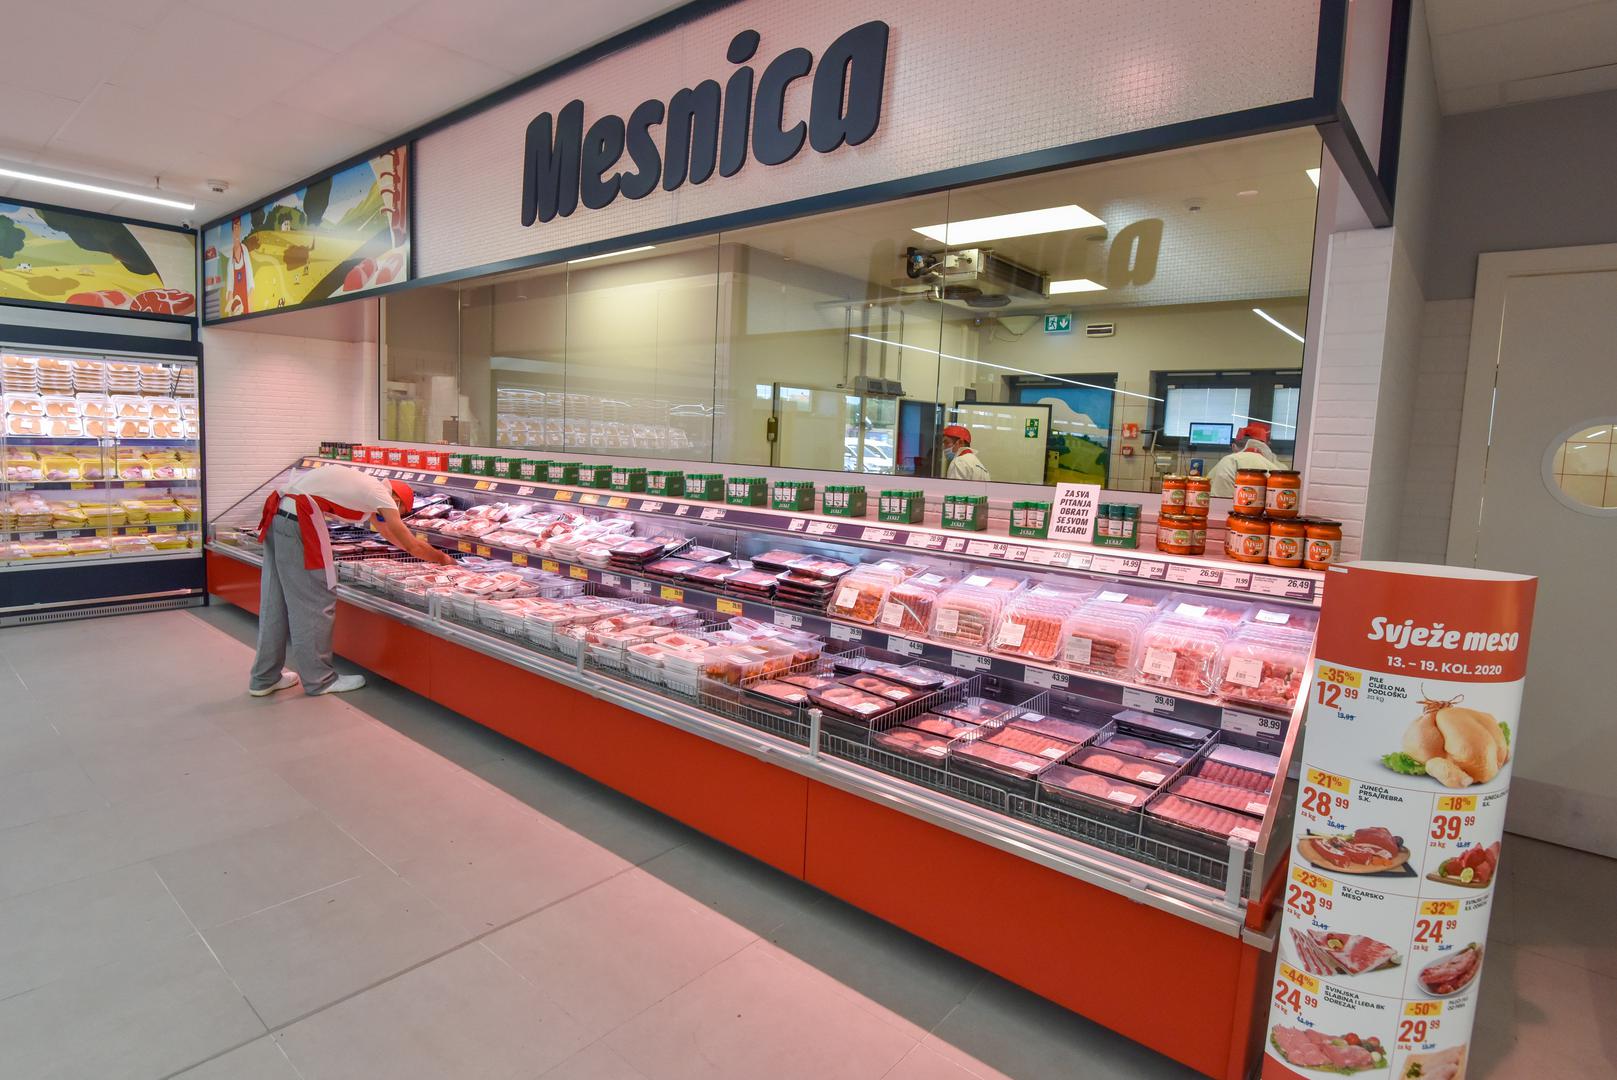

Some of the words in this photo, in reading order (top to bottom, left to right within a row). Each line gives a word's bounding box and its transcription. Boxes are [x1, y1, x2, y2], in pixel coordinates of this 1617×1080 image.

[521, 20, 889, 227] Mesnica
[1060, 499, 1092, 507] PITANJA
[1060, 508, 1089, 516] OBRATI
[1056, 516, 1066, 524] SE
[1066, 517, 1089, 526] SVOM
[1055, 525, 1087, 535] MESARU
[1200, 569, 1220, 578] 26.99
[1287, 579, 1310, 589] 26.49
[1367, 616, 1461, 650] Svježe
[1462, 631, 1520, 652] meso
[909, 641, 923, 651] 44.99
[976, 656, 991, 666] 41.99
[1387, 655, 1406, 668] 13.
[1420, 660, 1438, 672] 19.
[1441, 662, 1473, 675] KOL.
[1474, 665, 1503, 676] 2020
[1051, 673, 1070, 684] 43.99
[1323, 667, 1355, 684] -35%
[1369, 676, 1384, 684] PILE
[1367, 687, 1408, 699] PODLOŠKU
[1368, 682, 1394, 691] CIJELO
[1154, 695, 1175, 707] 39.49
[1258, 718, 1281, 731] 38.99
[1313, 771, 1343, 789] -21%
[1358, 789, 1404, 803] PRSA/REBRA
[1444, 796, 1471, 811] -18%
[1297, 871, 1327, 889] -23%
[1341, 892, 1362, 902] MESO
[1342, 886, 1354, 894] SV.
[1354, 889, 1385, 901] CARSKO
[1425, 902, 1455, 915] -32%
[1283, 968, 1314, 987] -44%
[1324, 990, 1354, 1004] SLABINA
[1325, 985, 1360, 999] SVINJSKA
[1323, 996, 1357, 1010] ODREZAK
[1410, 1002, 1438, 1016] -50%
